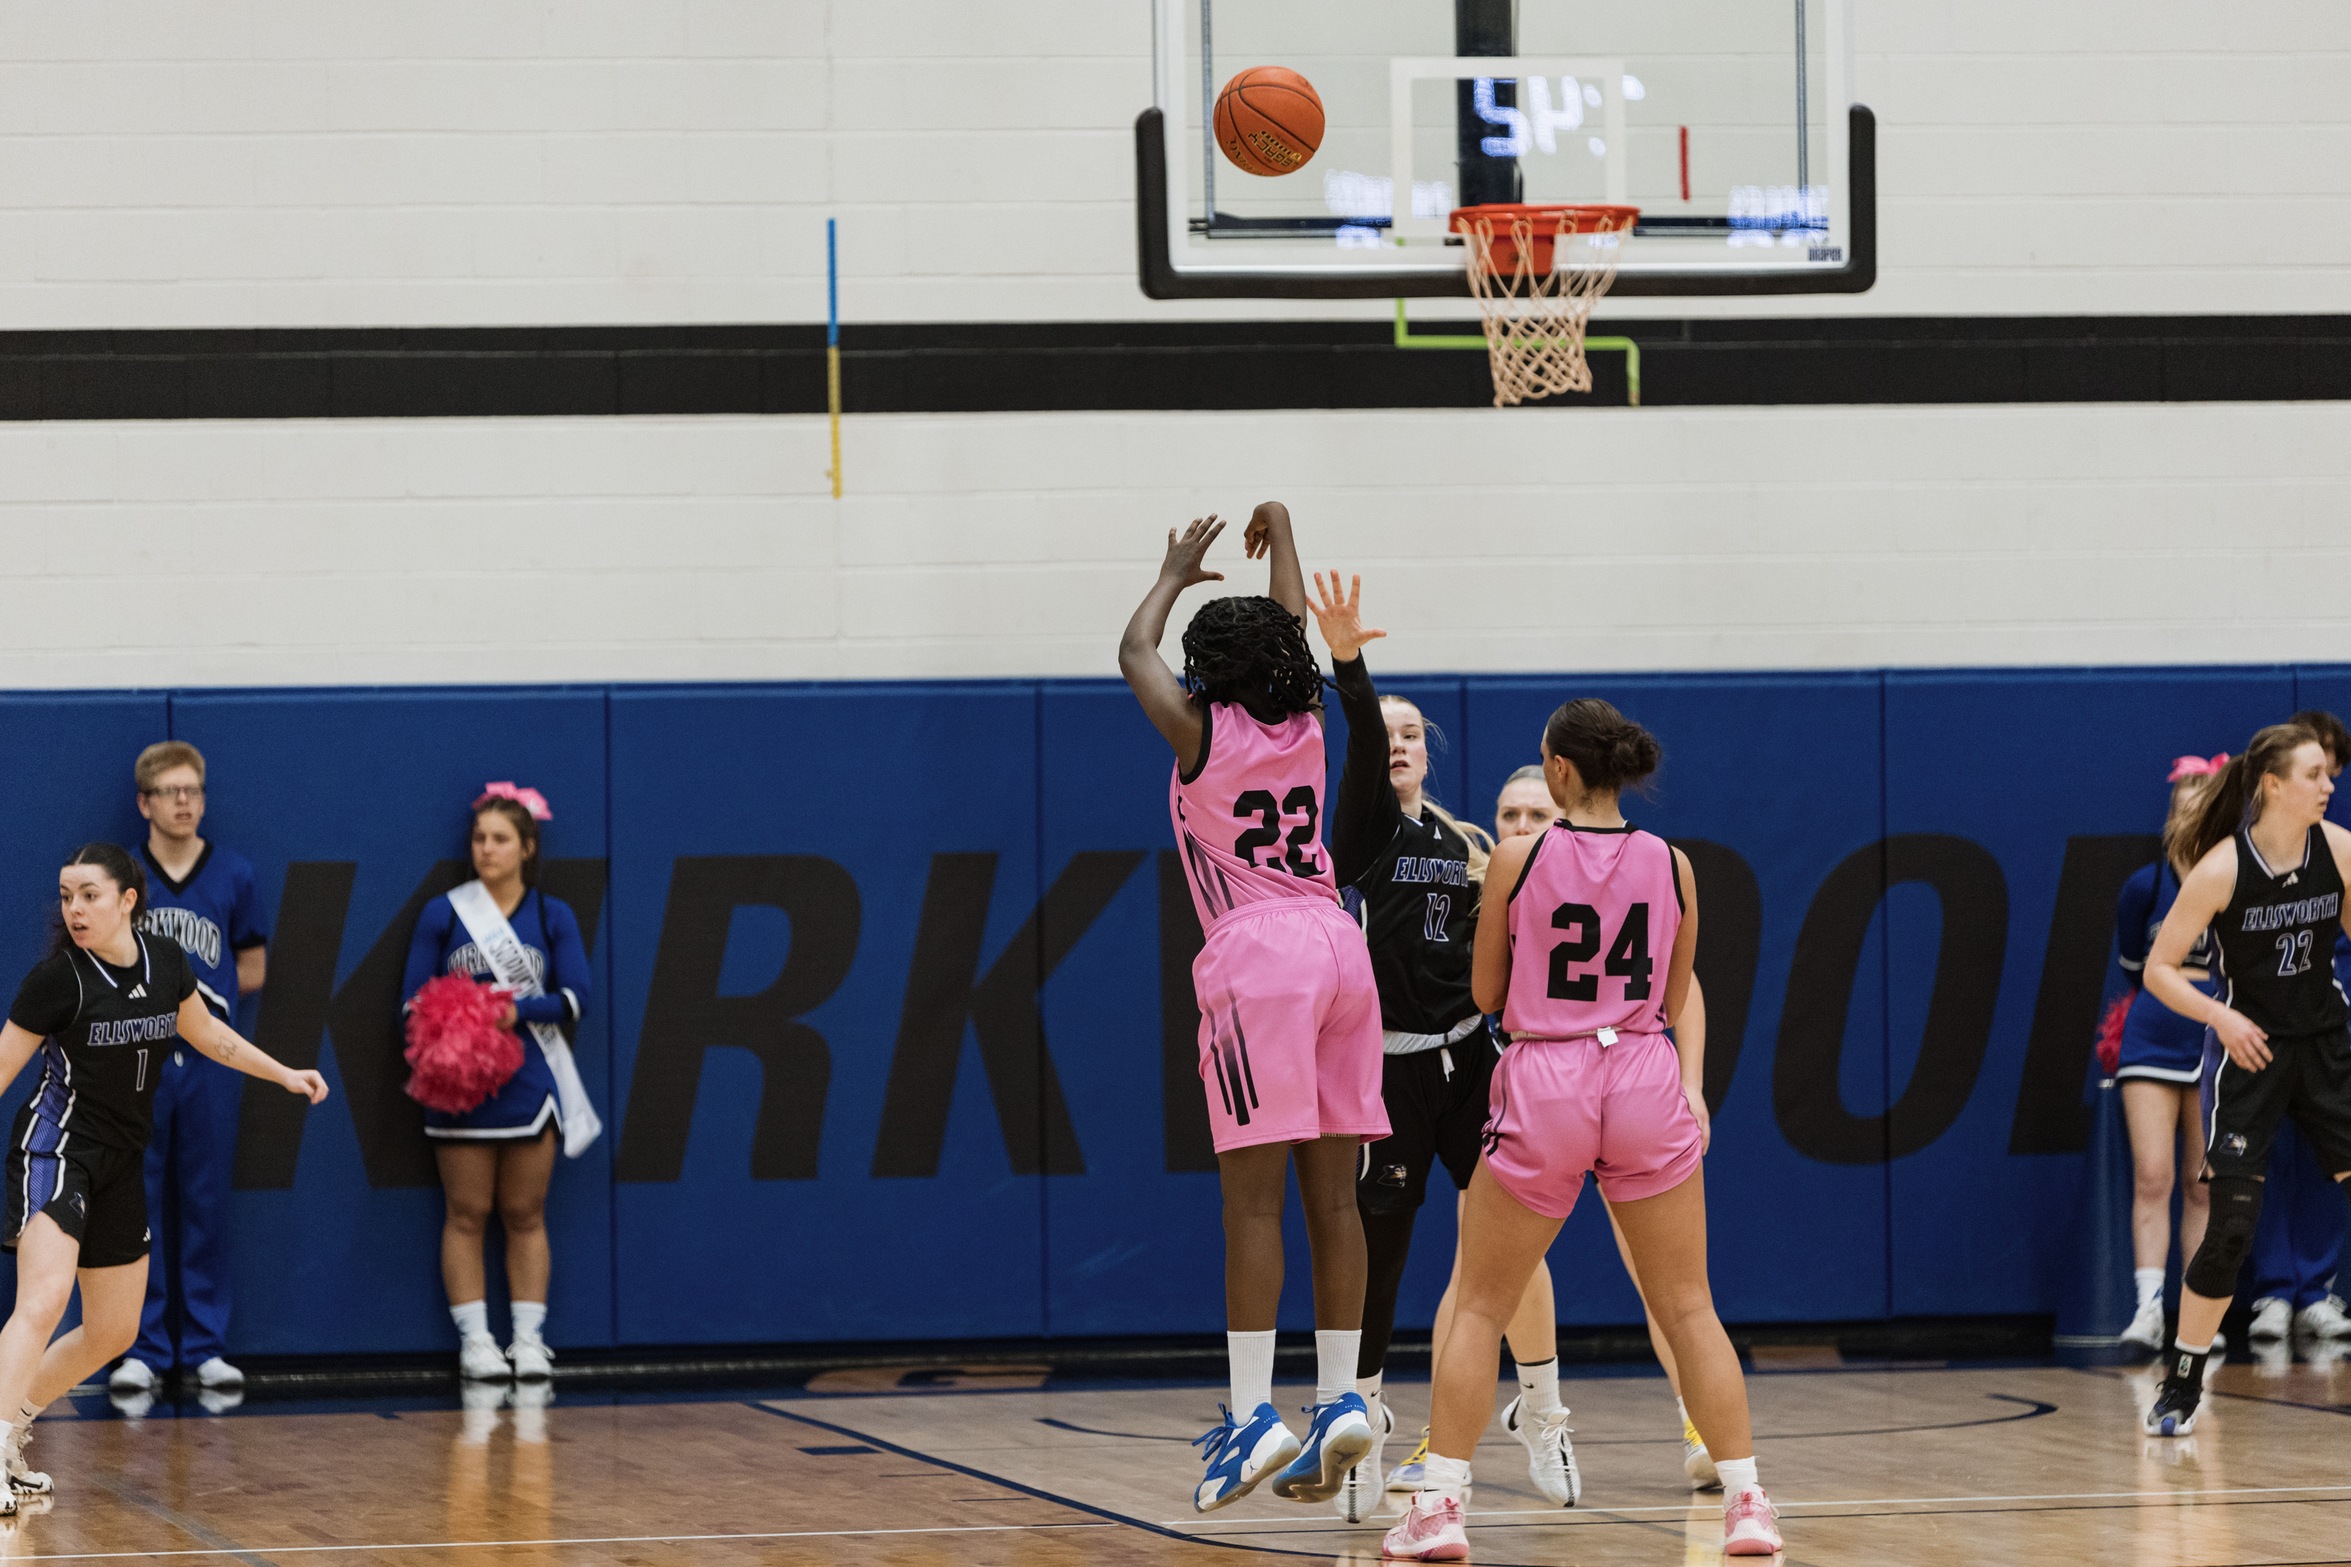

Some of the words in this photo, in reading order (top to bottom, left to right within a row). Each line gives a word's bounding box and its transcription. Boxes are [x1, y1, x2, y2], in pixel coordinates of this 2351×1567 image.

[1233, 785, 1326, 878] 22
[1424, 893, 1450, 942] 12
[2241, 891, 2339, 932] ELLSWORTH
[1547, 902, 1653, 1002] 24
[2276, 929, 2314, 977] 22
[87, 1011, 177, 1047] ELLSWORT
[136, 1049, 148, 1092] 1
